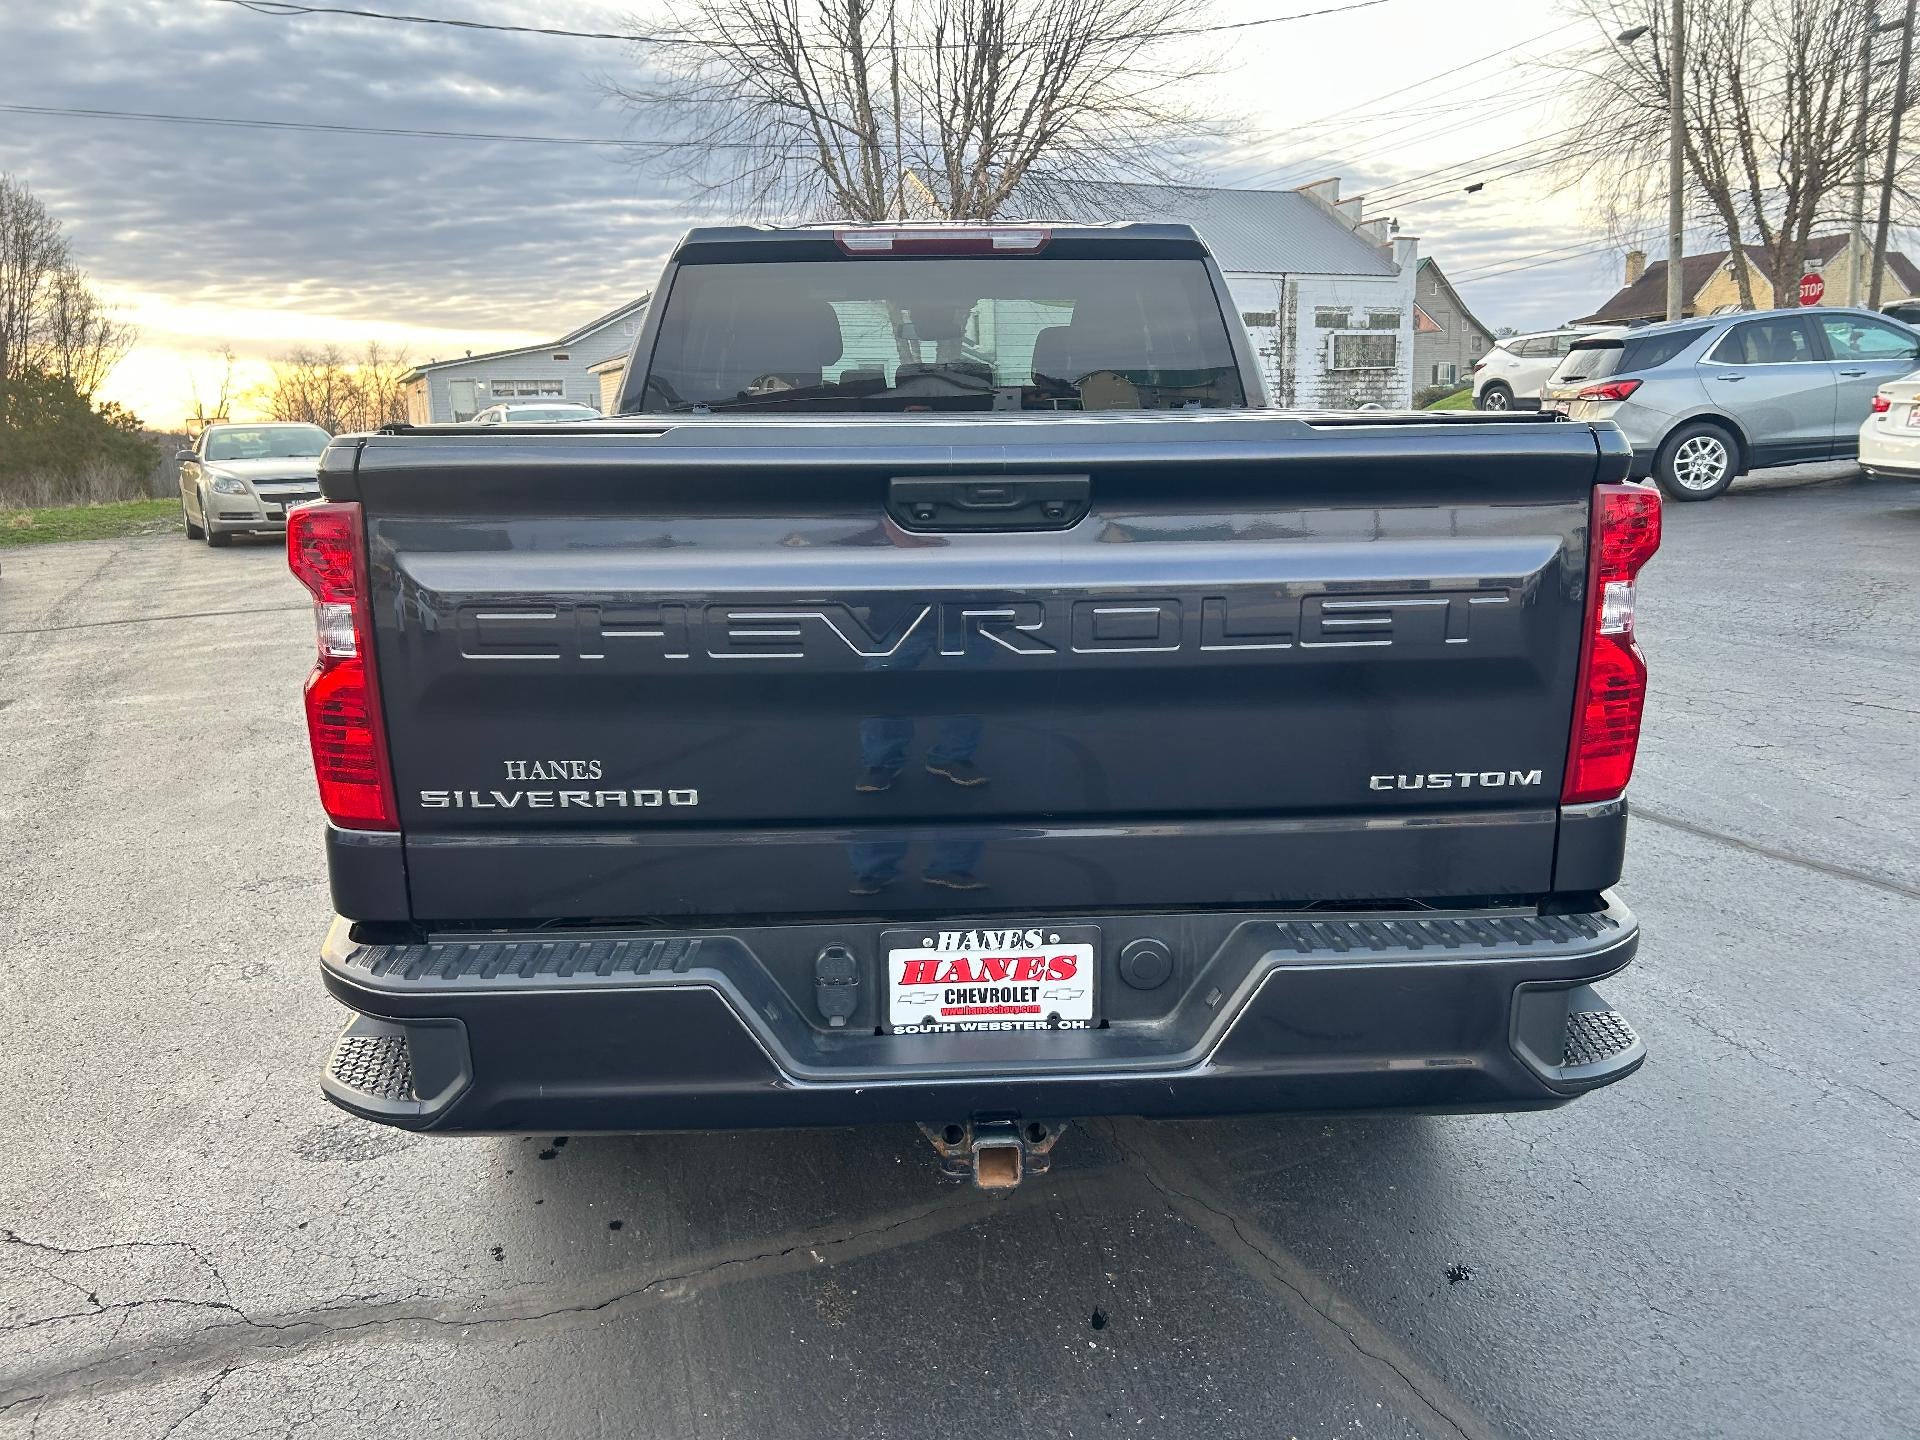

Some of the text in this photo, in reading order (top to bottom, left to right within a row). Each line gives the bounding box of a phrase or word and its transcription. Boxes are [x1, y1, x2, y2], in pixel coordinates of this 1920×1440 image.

[1799, 282, 1823, 298] STOP
[457, 588, 1510, 659] CHEVROLET
[504, 760, 602, 780] HANES
[1369, 769, 1543, 791] CUSTOM
[420, 789, 699, 808] SILVERADO
[934, 928, 1044, 952] HANES
[898, 955, 1078, 986] HANES
[944, 986, 1040, 1005] CHEVROLET
[940, 1004, 1041, 1017] www.haneschevy.com
[893, 1019, 1091, 1035] SOUTH WEBSTER, OH.
